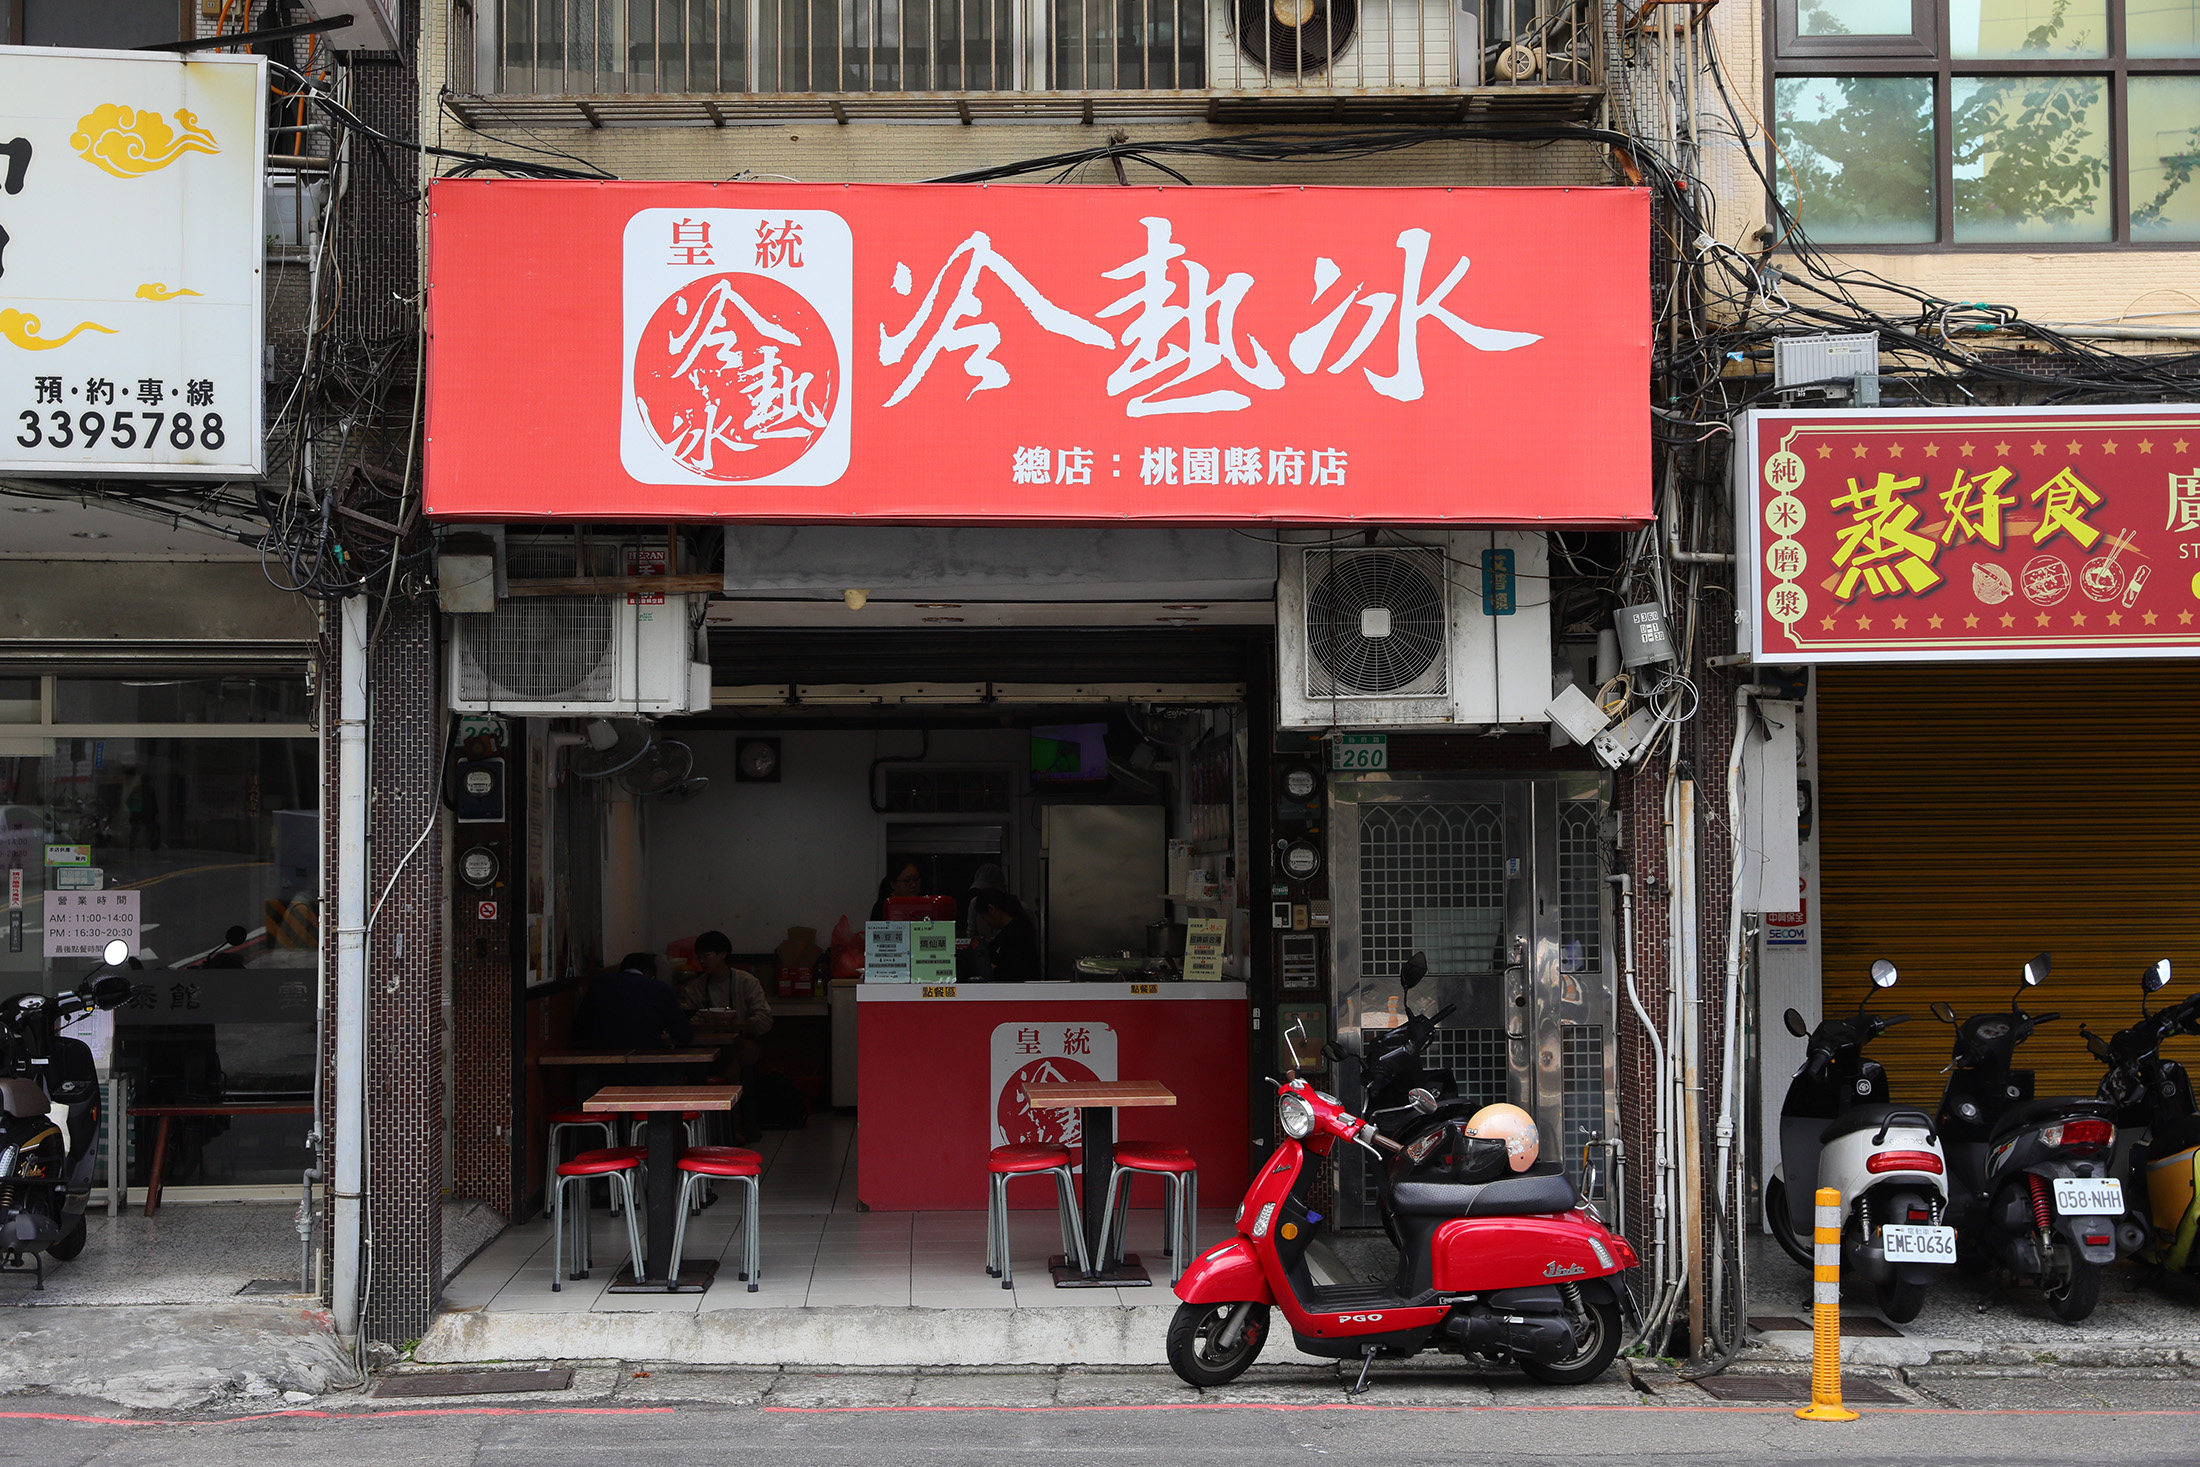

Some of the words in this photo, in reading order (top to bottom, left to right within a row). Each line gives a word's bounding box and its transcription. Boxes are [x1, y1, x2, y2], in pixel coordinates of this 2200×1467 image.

[667, 218, 804, 269] 皇統
[879, 216, 1544, 418] 冷熱冰
[16, 410, 226, 451] 3395788
[1770, 457, 1801, 617] 純米磨漿
[1830, 465, 2103, 600] 蒸好食
[628, 552, 664, 560] HERAN
[1633, 611, 1659, 623] 5360
[1343, 749, 1383, 767] 260
[58, 896, 127, 906] 營業時間
[75, 914, 134, 922] 11:00~14:00
[75, 928, 133, 937] 16:30~20:30
[1769, 929, 1804, 938] SECOM
[922, 986, 957, 998] 點餐區
[1130, 984, 1158, 994] 點餐區
[1015, 1028, 1091, 1056] 皇統
[1338, 1314, 1383, 1323] PGO
